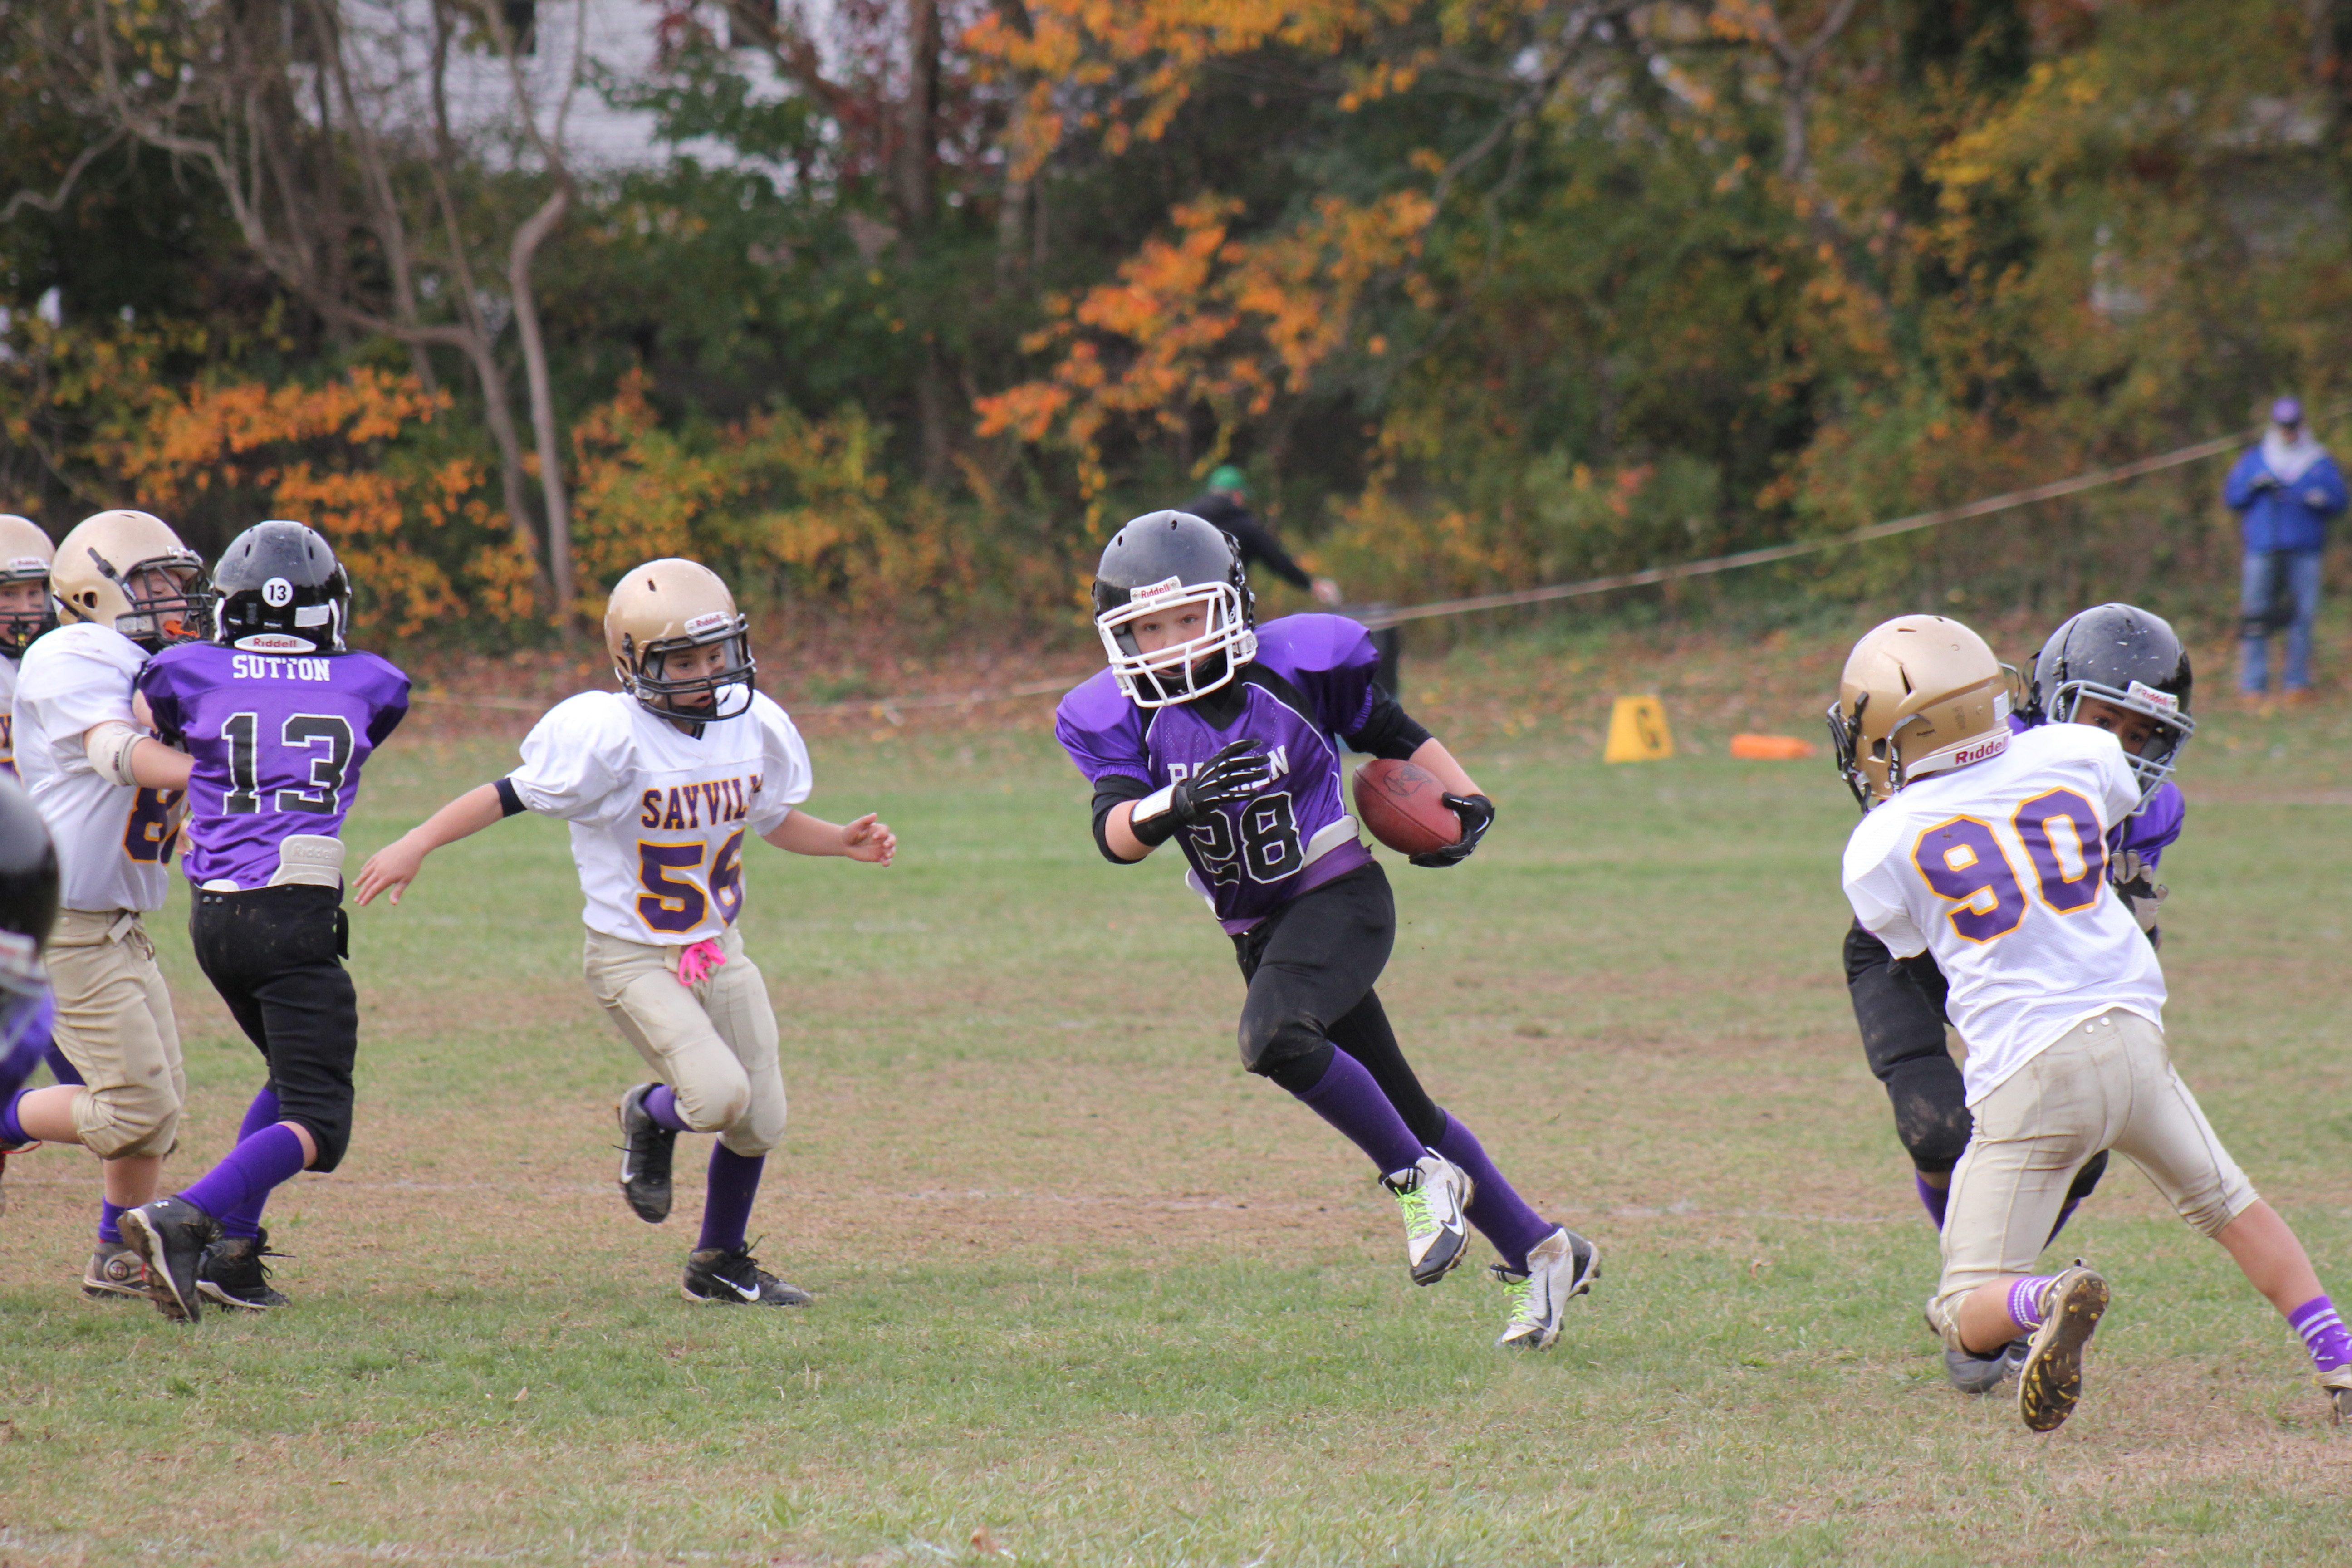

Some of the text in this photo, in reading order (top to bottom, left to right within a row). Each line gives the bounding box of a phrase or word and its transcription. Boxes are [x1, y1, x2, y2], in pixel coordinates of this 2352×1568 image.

[270, 585, 286, 601] 13
[1141, 583, 1170, 598] Riddell
[232, 654, 331, 681] SUTTON
[253, 638, 297, 647] Riddell
[221, 712, 355, 816] 13
[1186, 790, 1305, 886] 28
[1910, 785, 2109, 945] 90
[636, 823, 745, 935] 56
